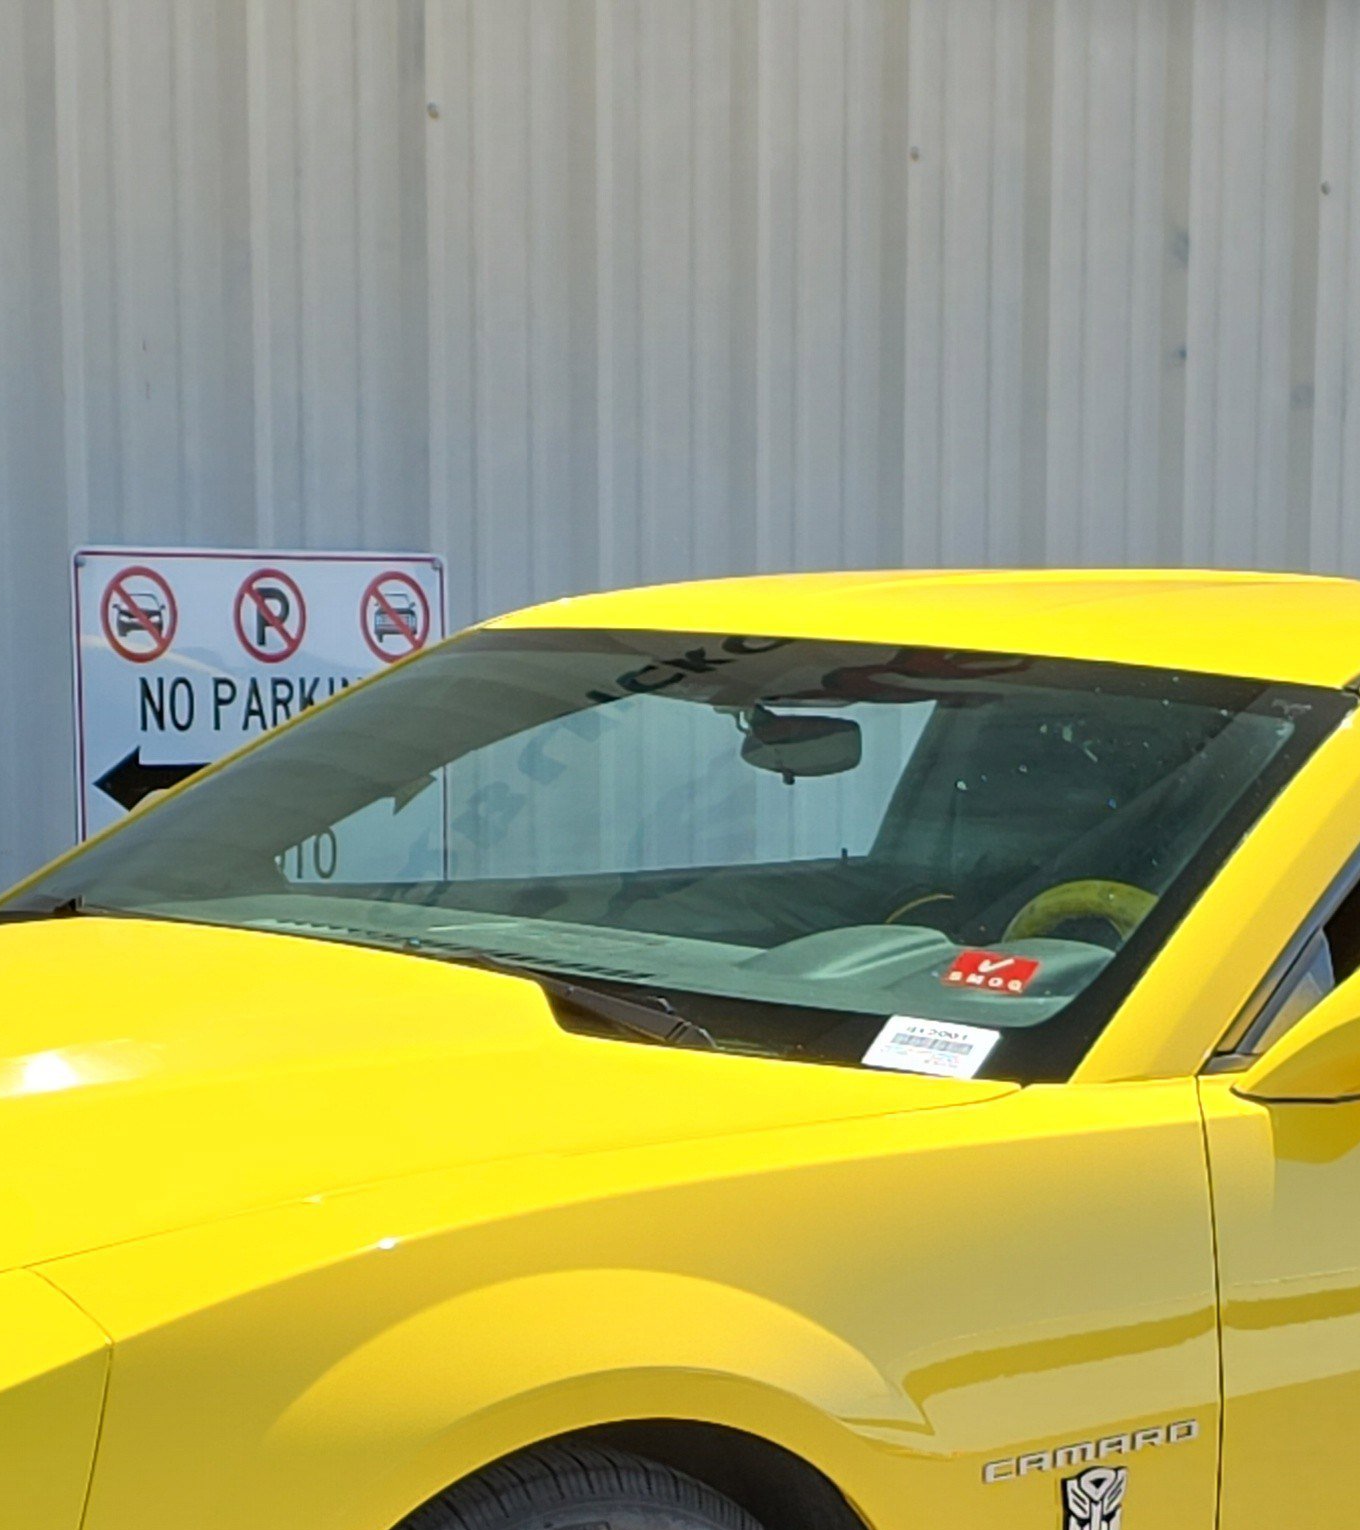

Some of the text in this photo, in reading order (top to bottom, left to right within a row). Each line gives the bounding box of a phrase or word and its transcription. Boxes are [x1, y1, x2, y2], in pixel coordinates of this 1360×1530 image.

[139, 677, 362, 732] NO PARK
[982, 1418, 1199, 1484] CAMARO
